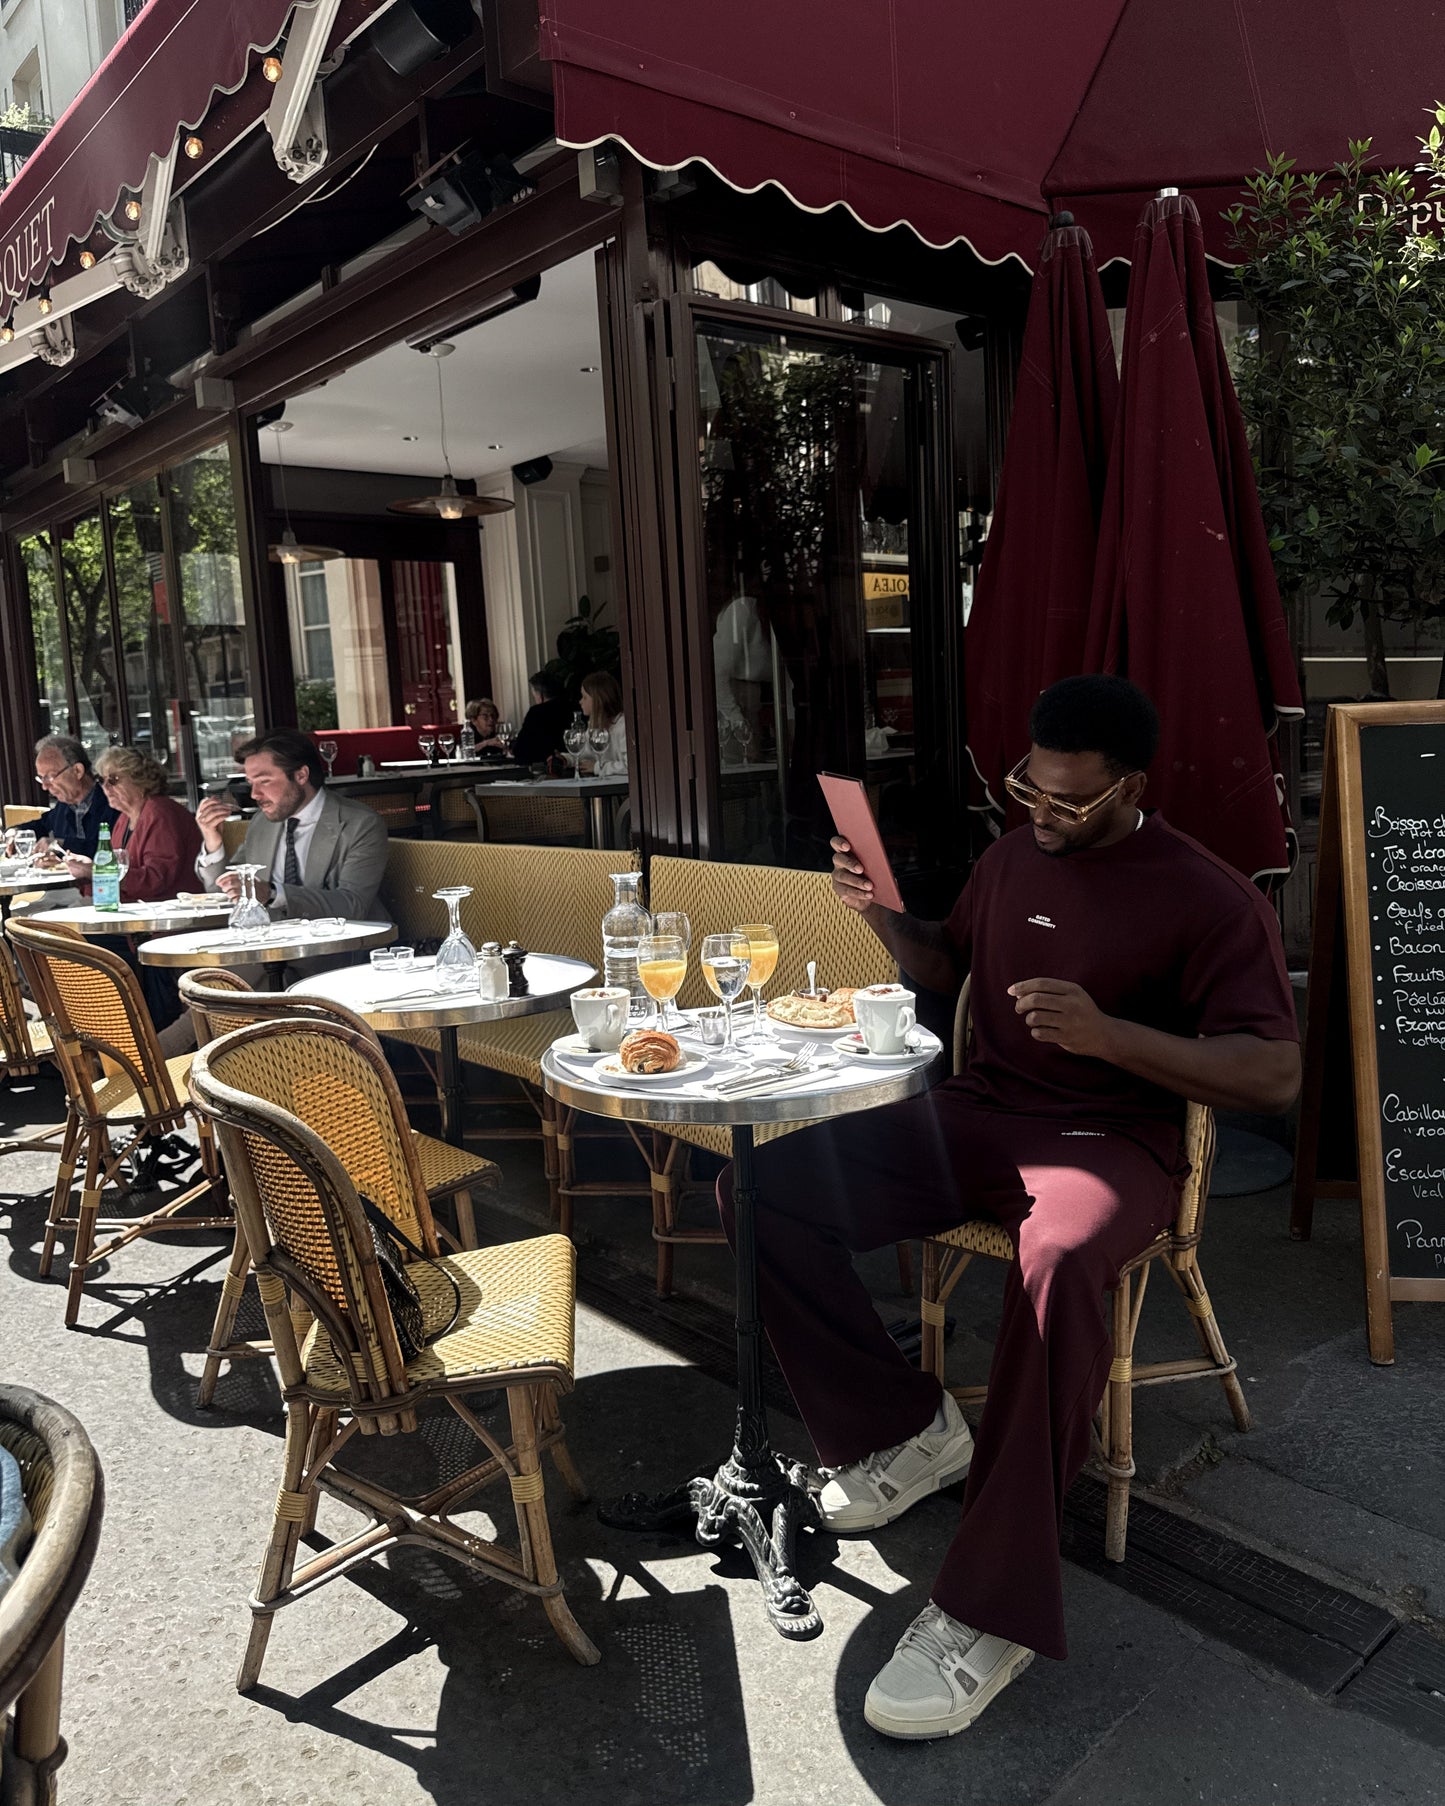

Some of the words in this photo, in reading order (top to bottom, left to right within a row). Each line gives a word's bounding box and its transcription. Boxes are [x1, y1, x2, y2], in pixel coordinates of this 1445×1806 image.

[0, 195, 55, 306] QUET
[1382, 844, 1407, 874] Jus
[1389, 936, 1445, 956] Bacon
[1412, 1182, 1444, 1199] Veal
